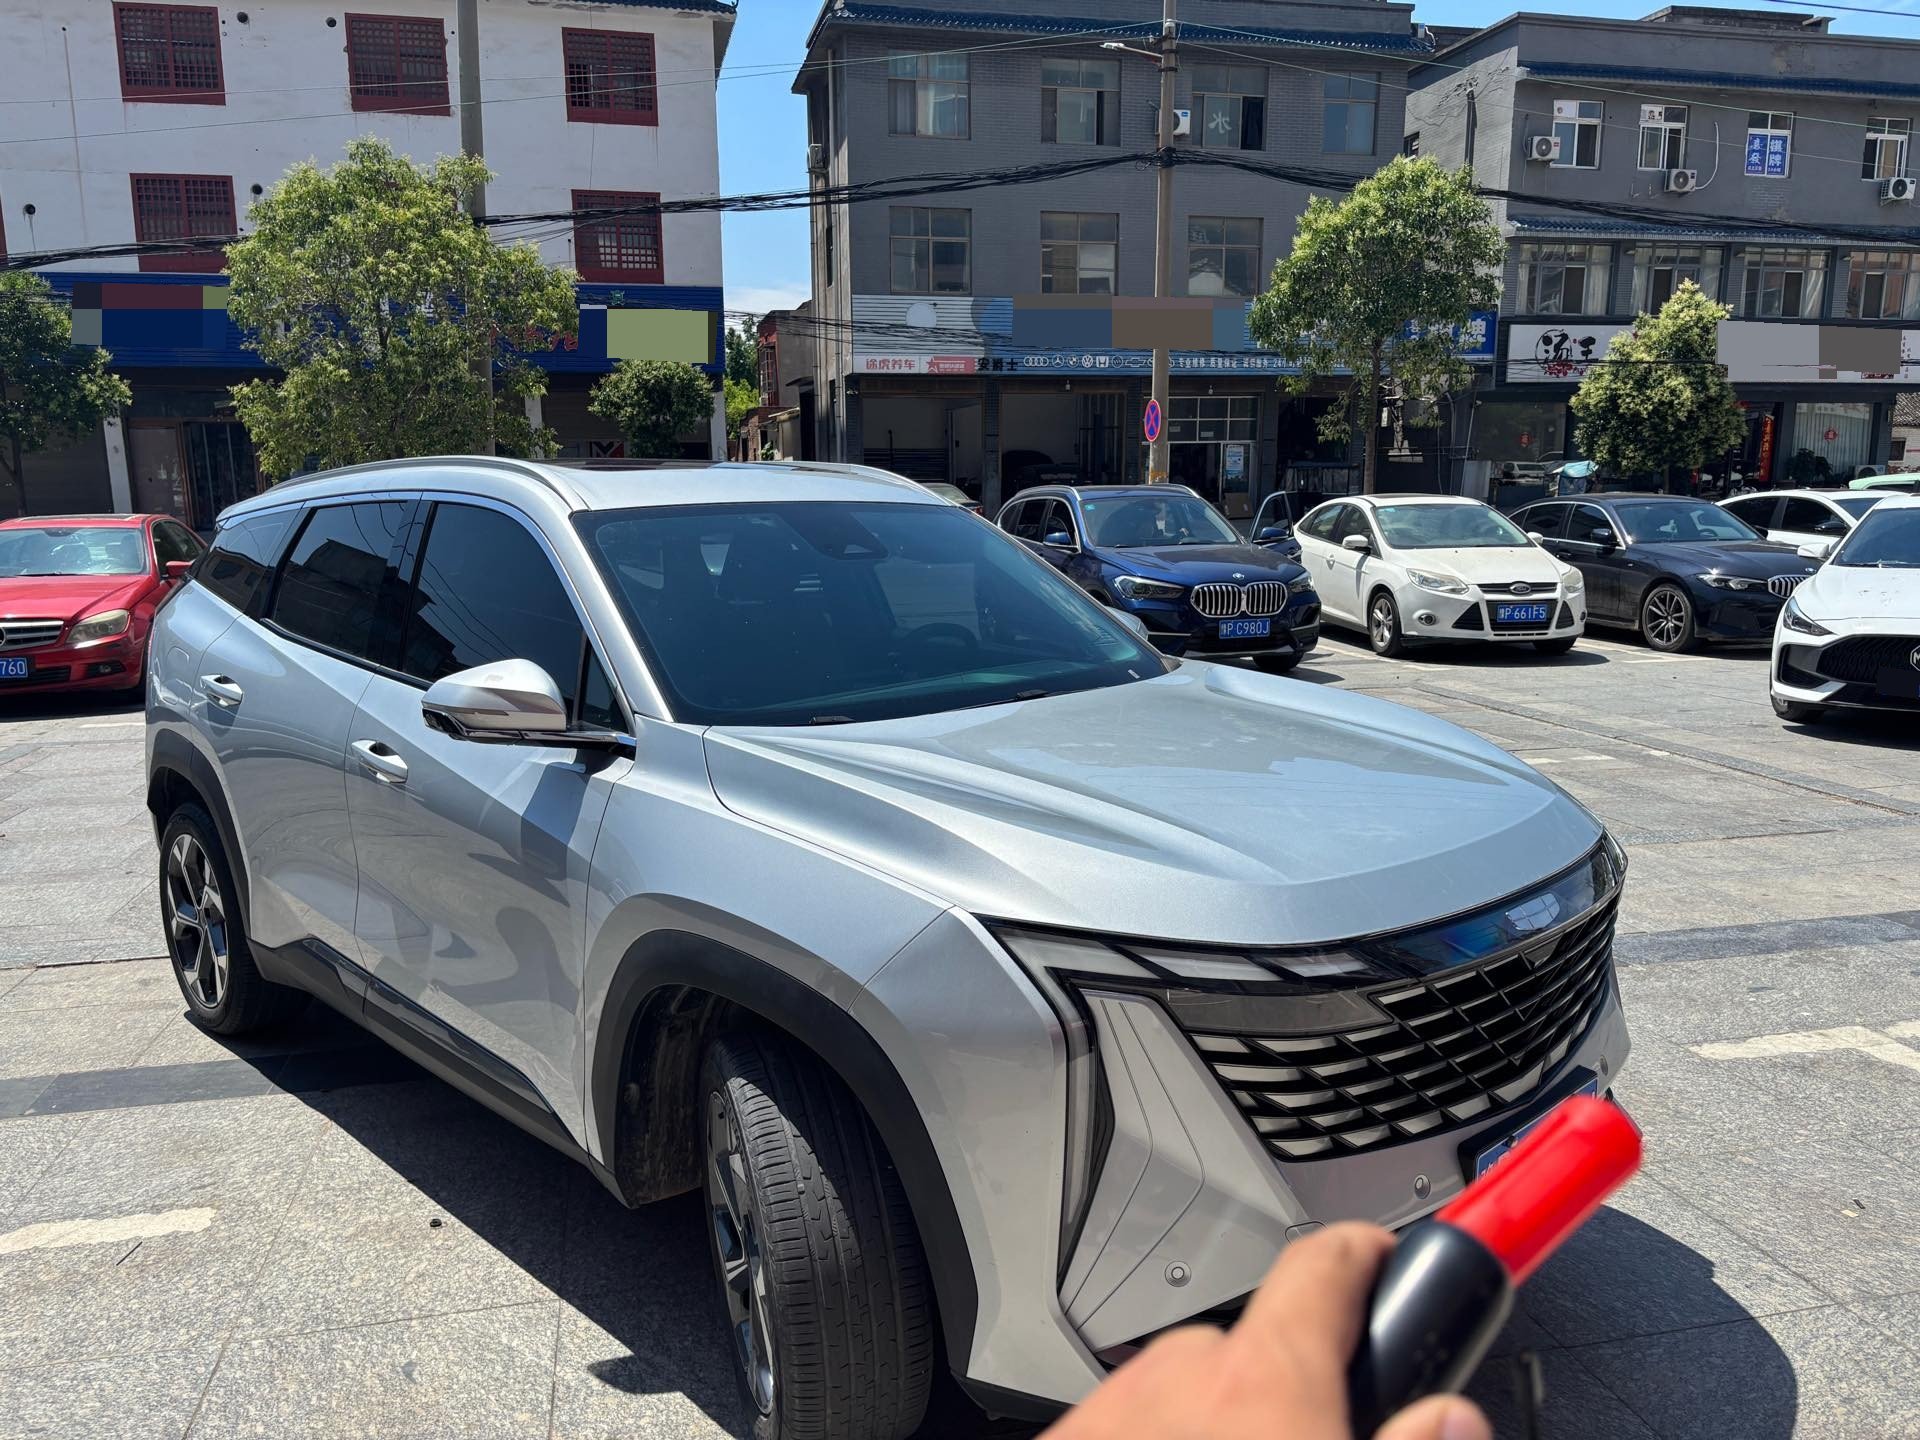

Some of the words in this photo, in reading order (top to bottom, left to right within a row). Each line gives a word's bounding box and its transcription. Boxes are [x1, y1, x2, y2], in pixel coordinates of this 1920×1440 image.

[866, 358, 916, 370] 途虎养车
[0, 661, 25, 675] 760
